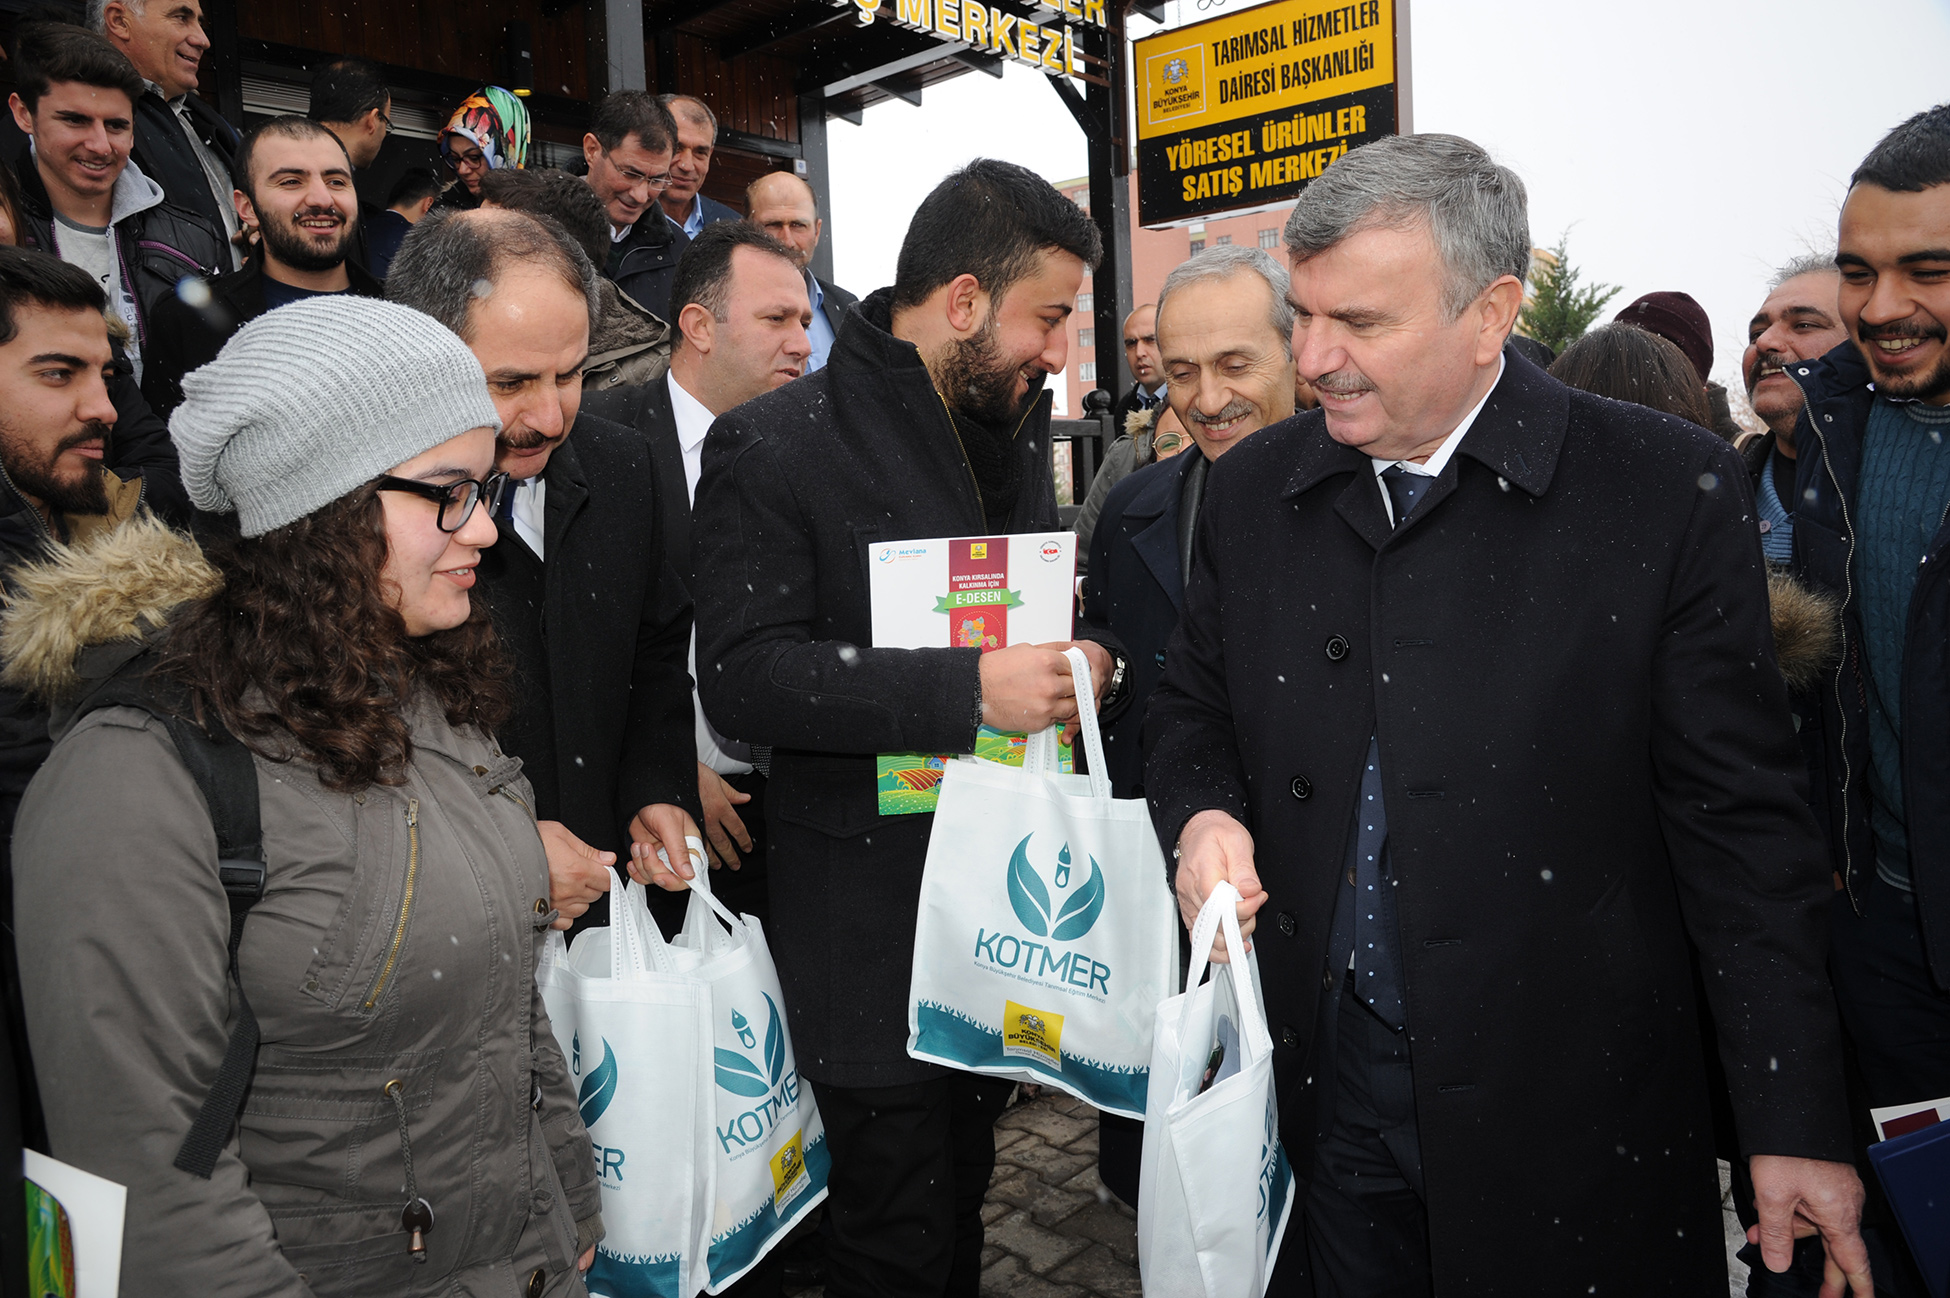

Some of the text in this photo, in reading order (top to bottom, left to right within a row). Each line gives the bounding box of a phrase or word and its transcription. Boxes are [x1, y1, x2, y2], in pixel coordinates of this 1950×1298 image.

[896, 0, 1074, 76] MERKEZİ
[1212, 0, 1380, 67] TARIMSAL HİZMETLER
[1165, 85, 1188, 96] KONYA
[1219, 40, 1374, 105] DAİRESİ BAŞKANLIĞI
[1166, 105, 1366, 172] YÖRESEL ÜRÜNLER
[1183, 166, 1243, 202] SATIŞ
[956, 591, 1001, 605] E-DESEN
[974, 961, 988, 970] Konya
[975, 928, 1111, 995] KOTMER
